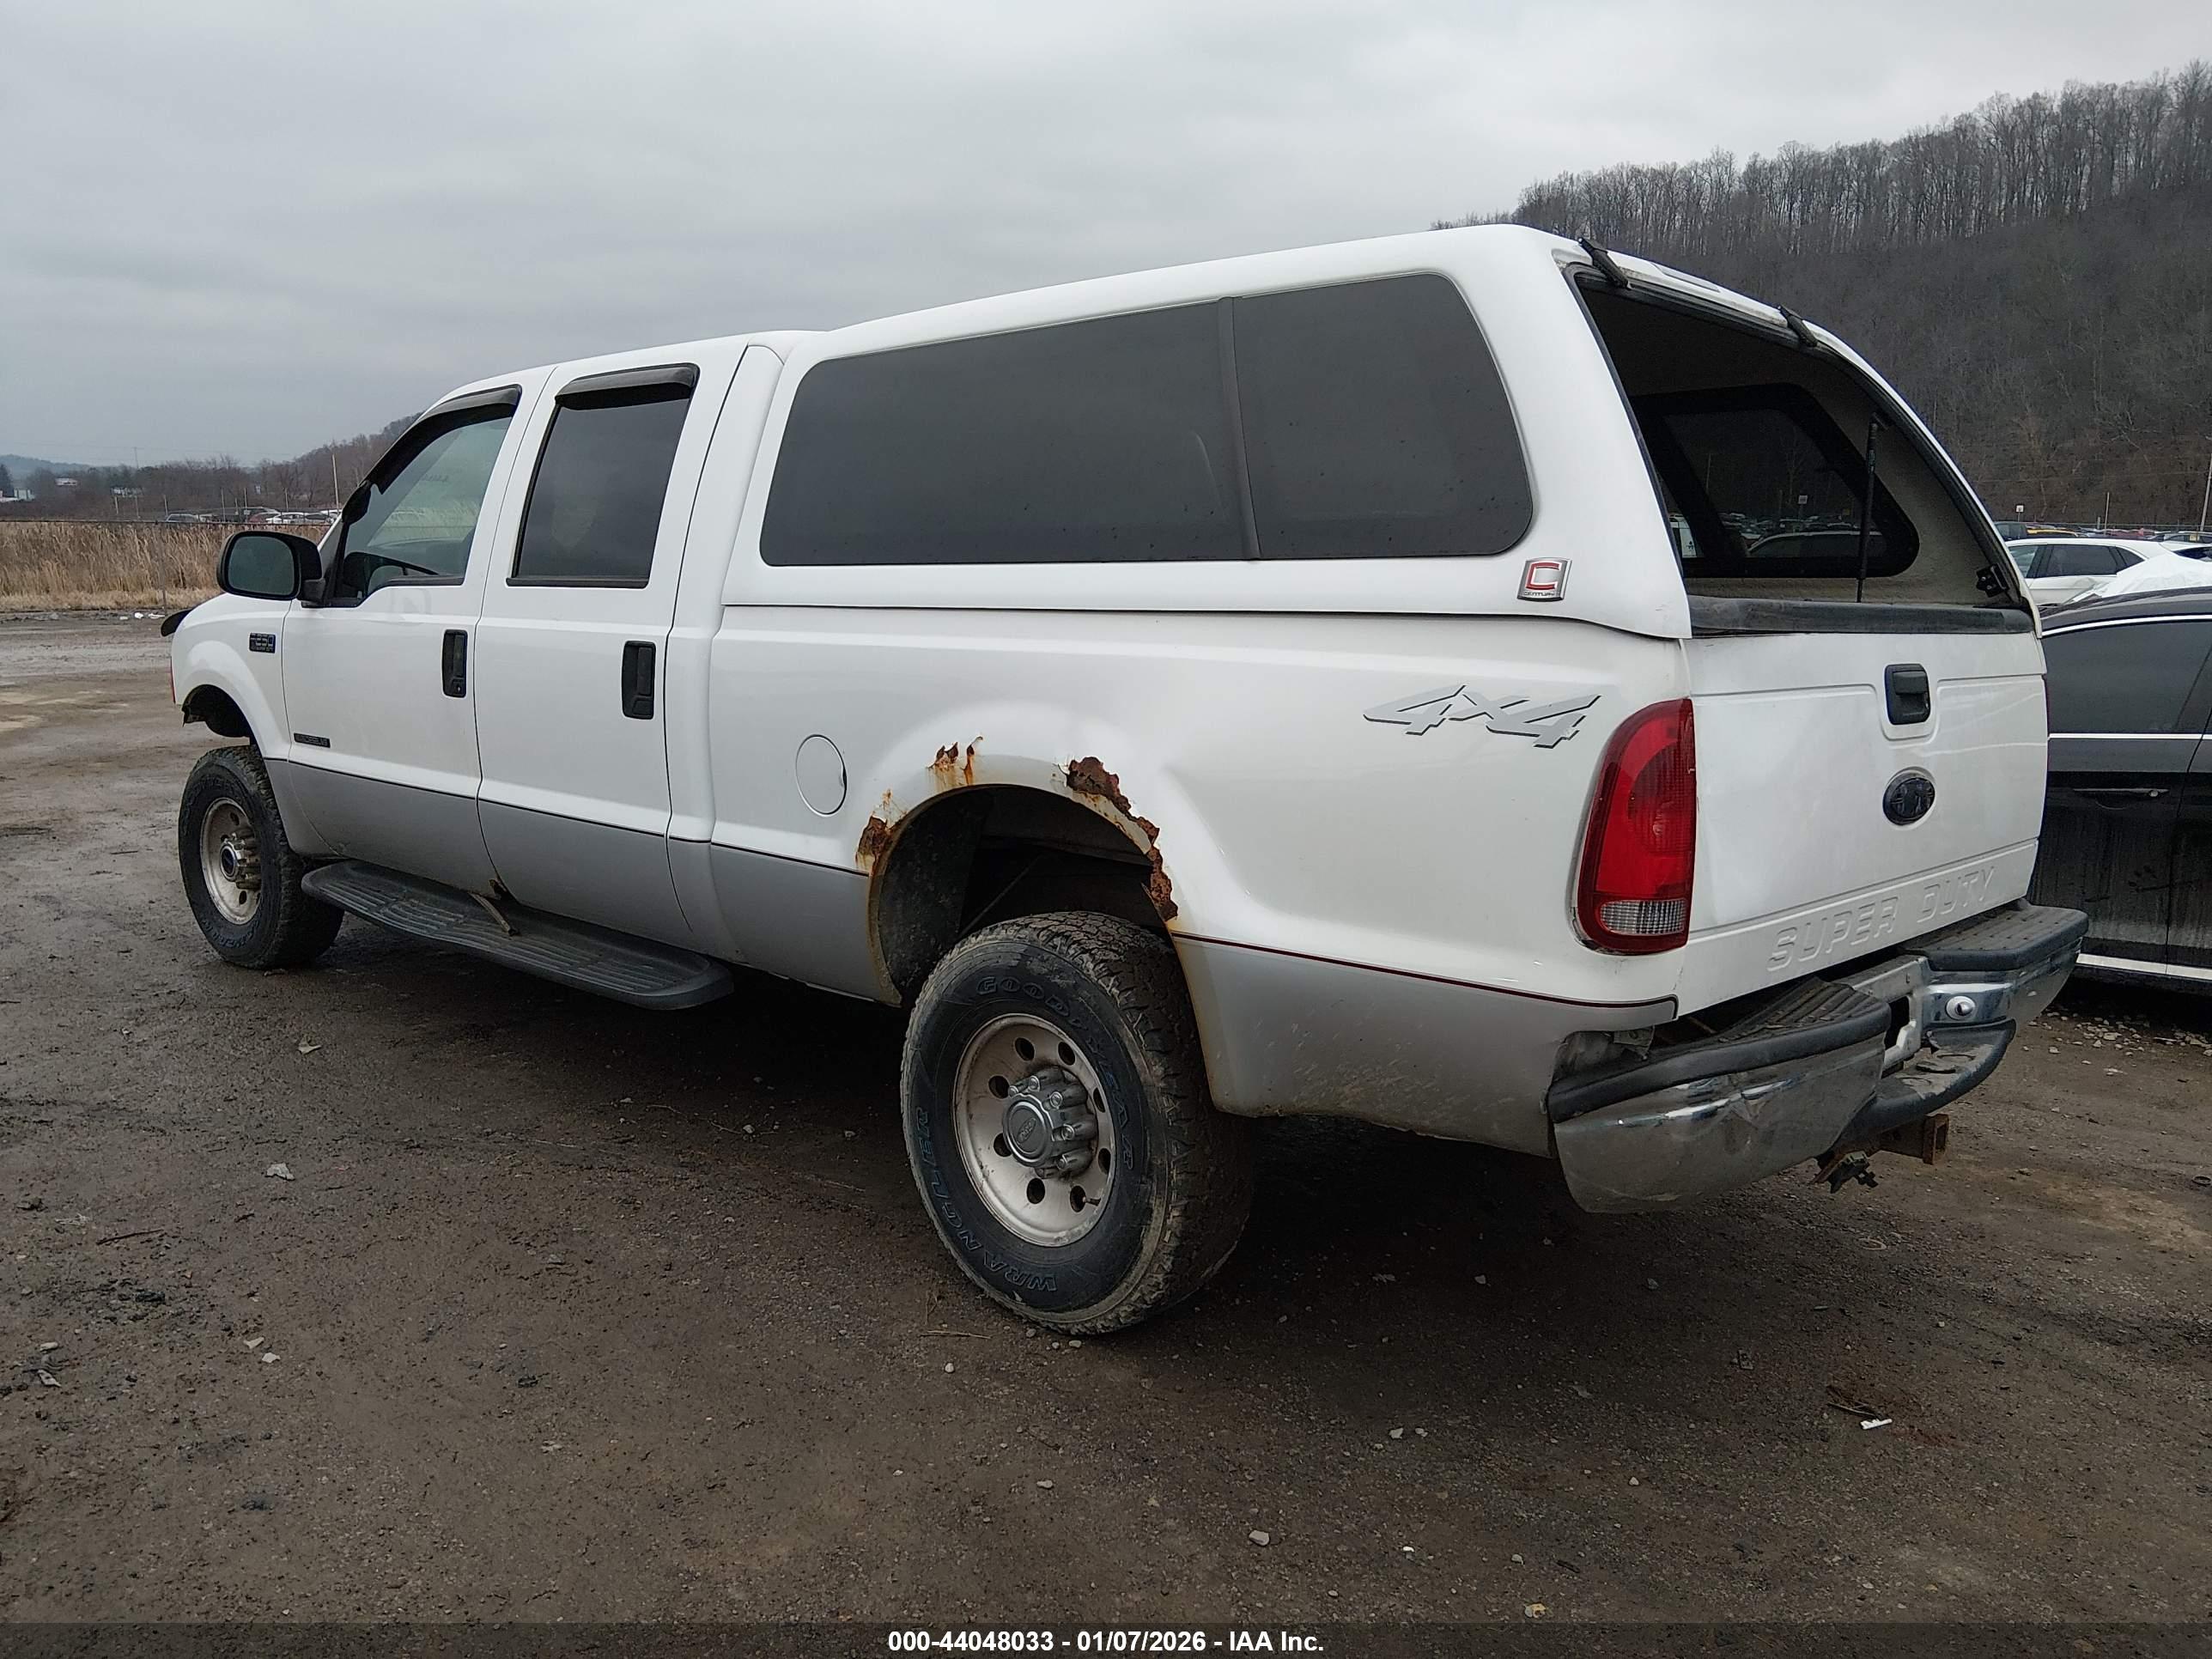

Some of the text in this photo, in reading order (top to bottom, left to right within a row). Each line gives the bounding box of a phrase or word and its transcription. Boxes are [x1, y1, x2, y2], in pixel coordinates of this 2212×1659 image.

[1765, 866, 1995, 972] SUPER DUTY
[915, 1106, 1059, 1292] WRANGLER
